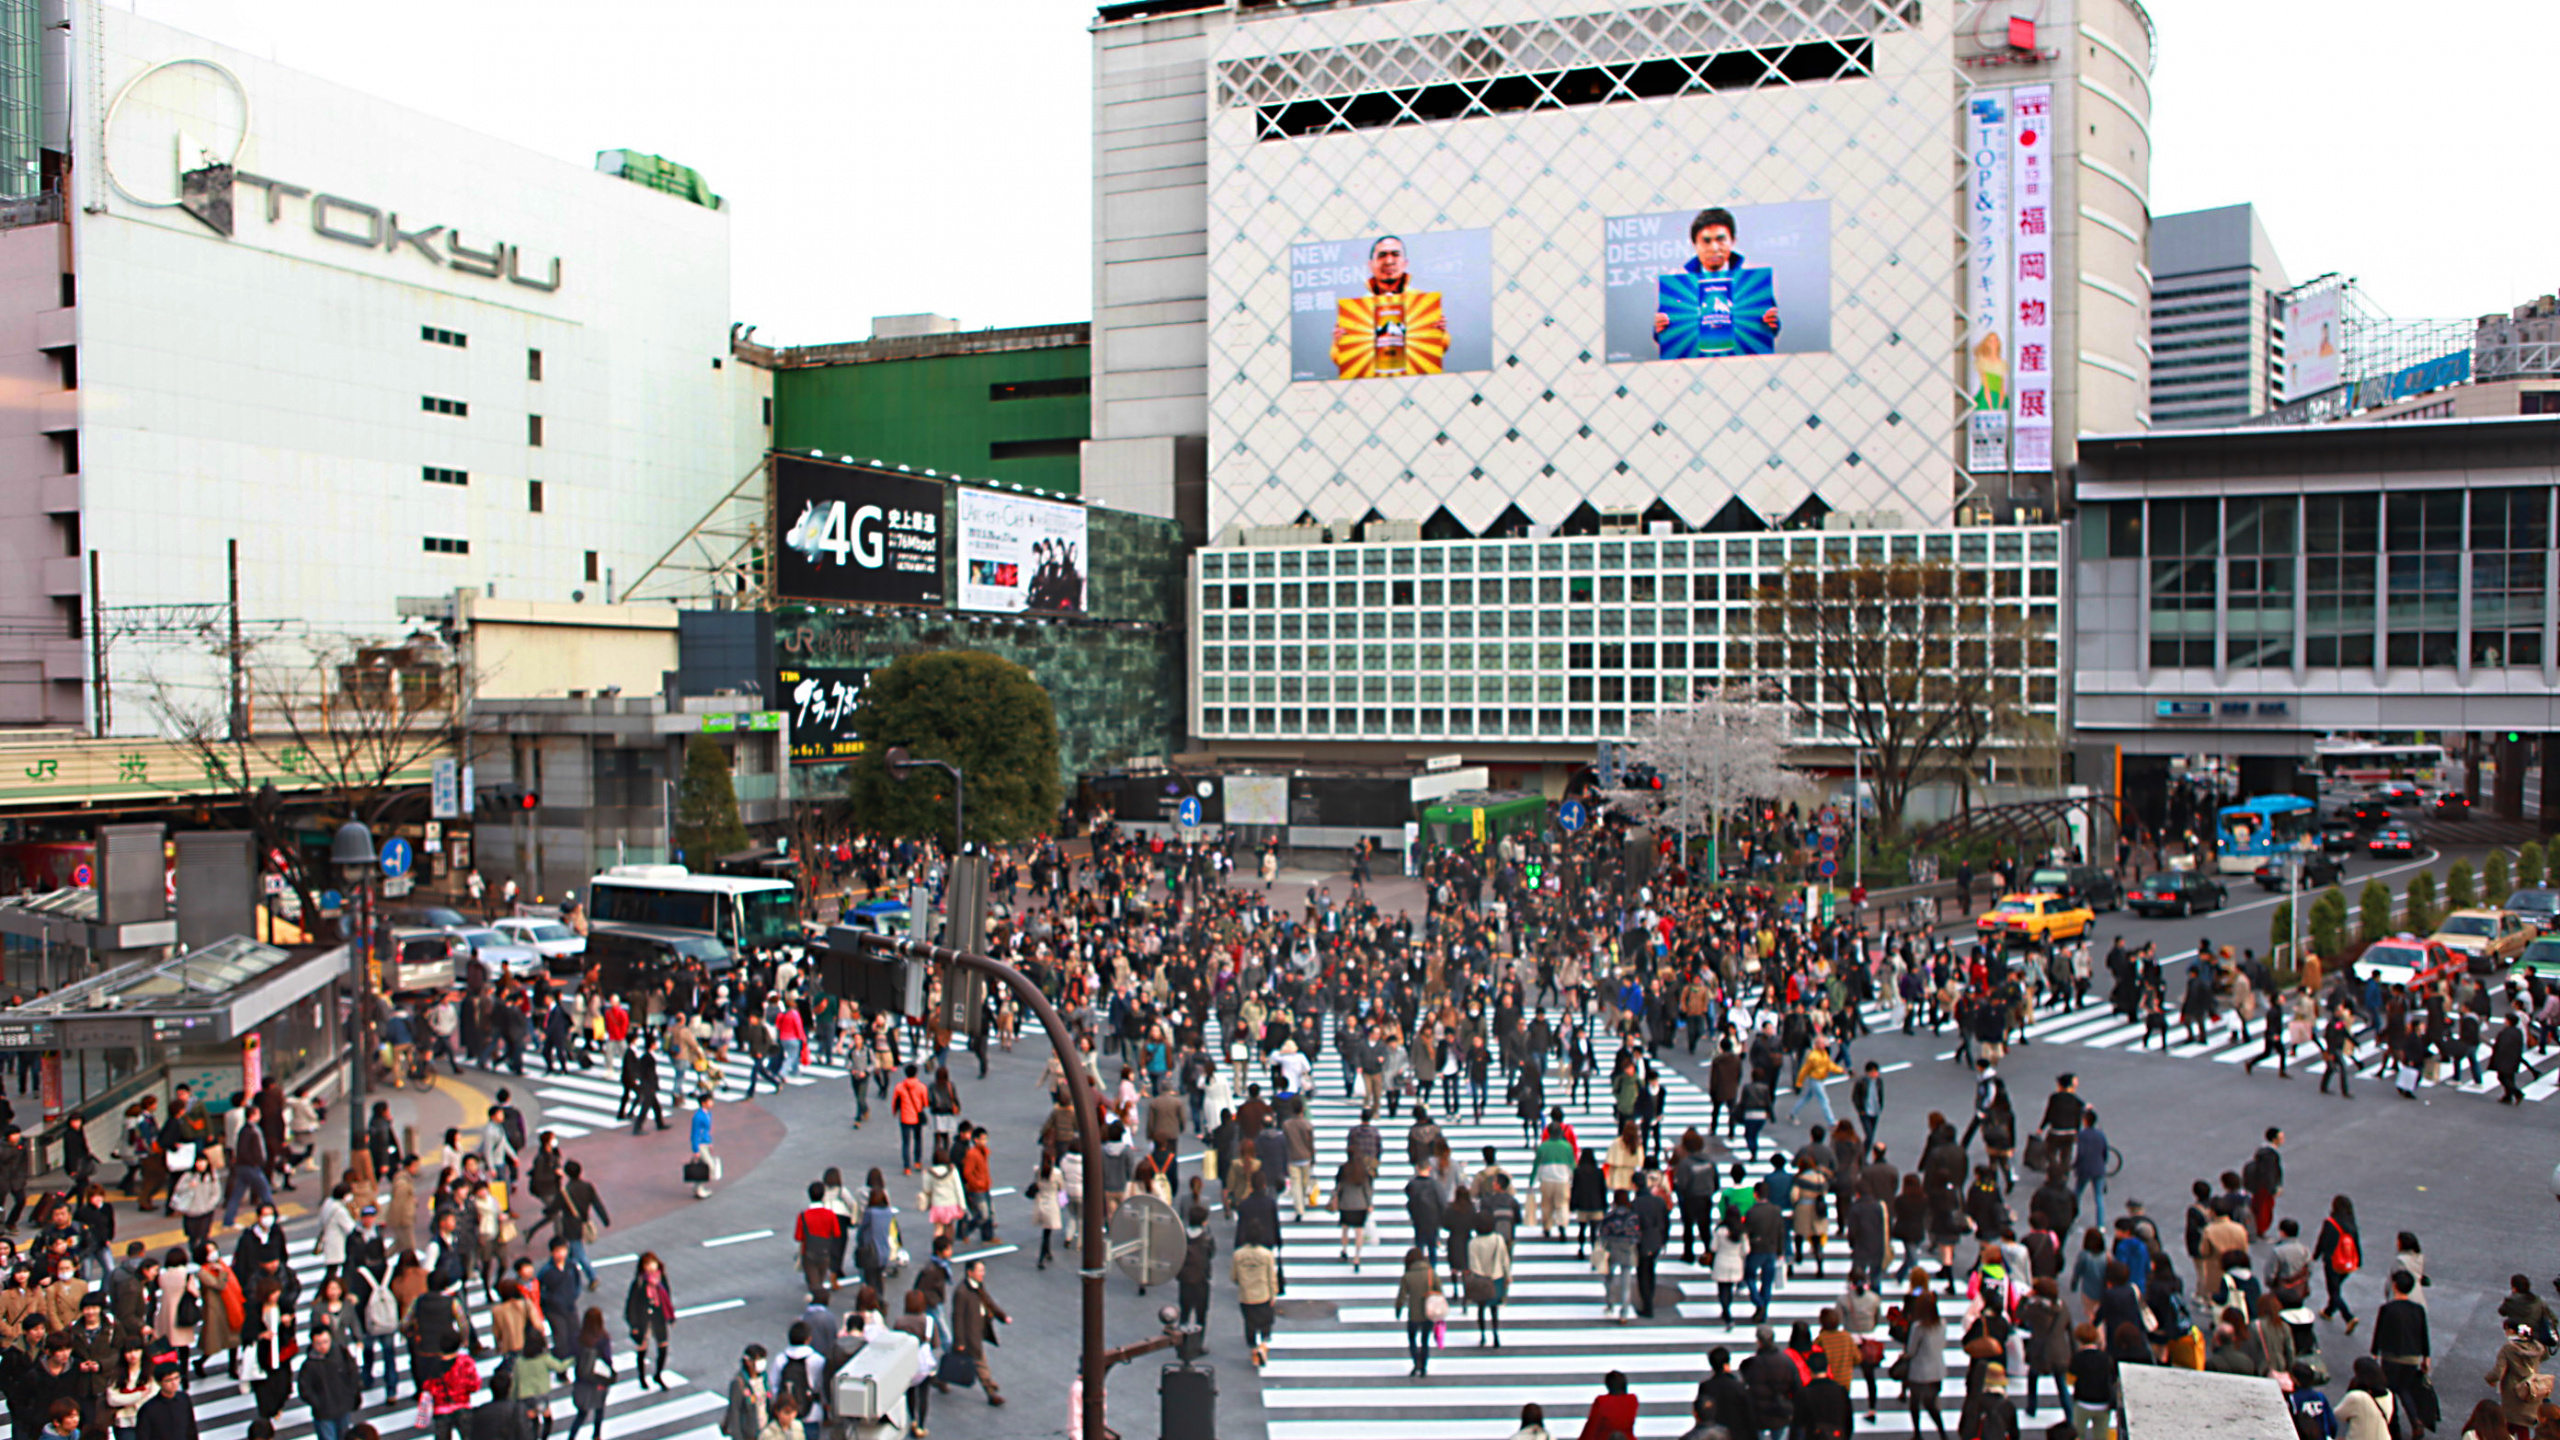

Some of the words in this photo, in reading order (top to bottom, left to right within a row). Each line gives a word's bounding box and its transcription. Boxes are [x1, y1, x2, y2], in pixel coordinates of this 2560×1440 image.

[234, 170, 561, 293] TOKYU
[1607, 216, 1662, 240] NEW
[1292, 243, 1342, 266] NEW
[1607, 239, 1694, 264] DESIGN
[1292, 265, 1370, 289] DESIGN
[2019, 205, 2047, 418] 福岡物産展
[818, 499, 884, 570] 4G
[25, 760, 58, 778] JR
